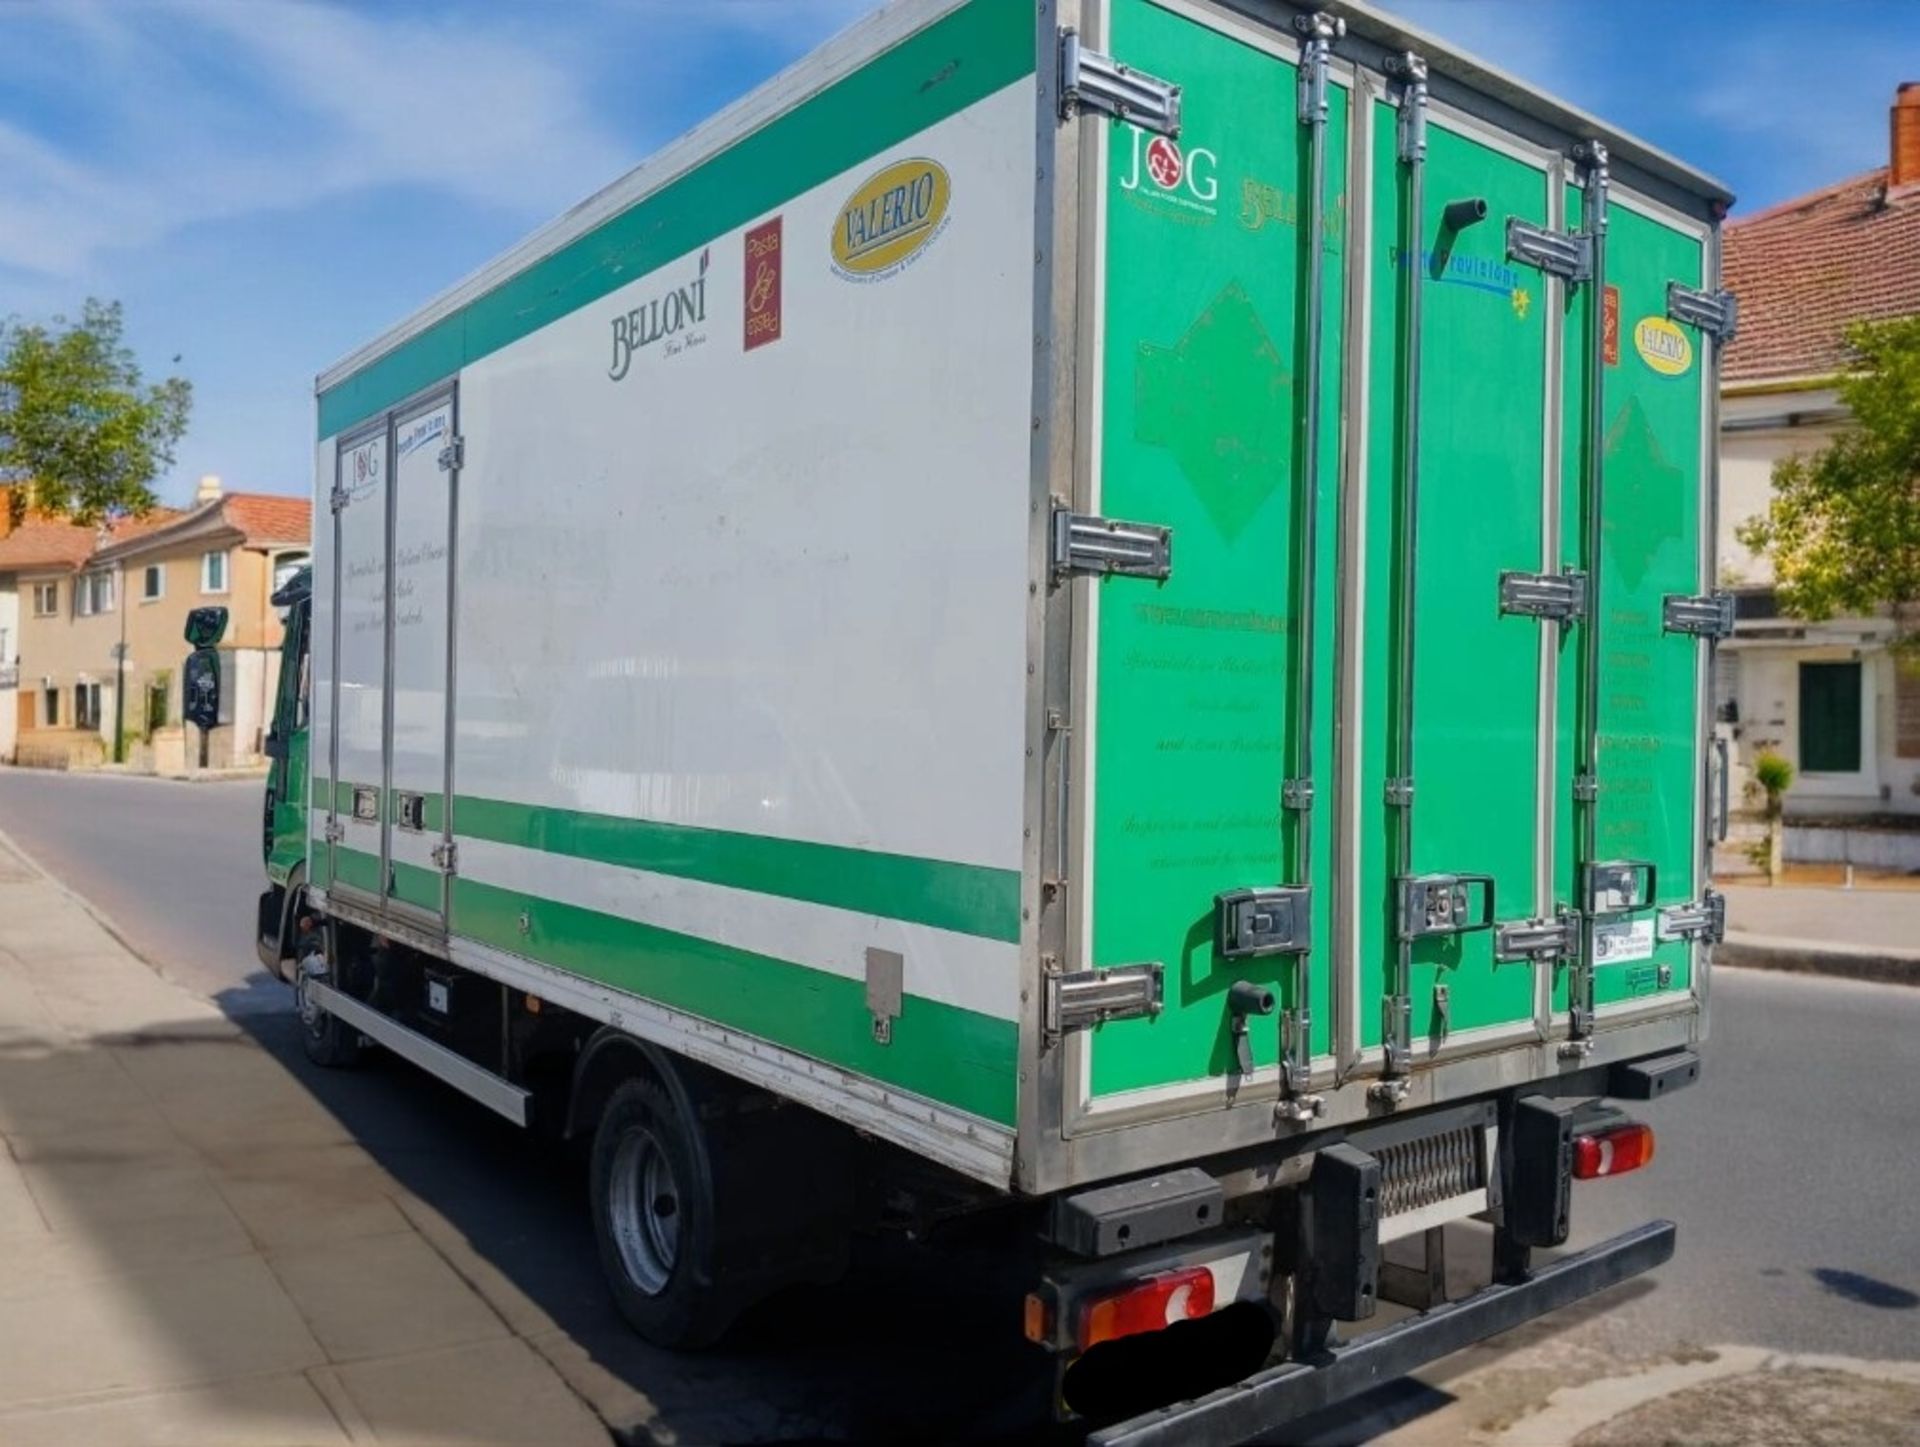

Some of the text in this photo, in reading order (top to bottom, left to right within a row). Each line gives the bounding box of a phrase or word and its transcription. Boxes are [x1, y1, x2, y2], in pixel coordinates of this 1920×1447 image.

[845, 172, 933, 249] VALERIO
[746, 232, 779, 258] Pasta
[608, 270, 707, 382] BELLONI
[1640, 323, 1685, 360] VALERIO
